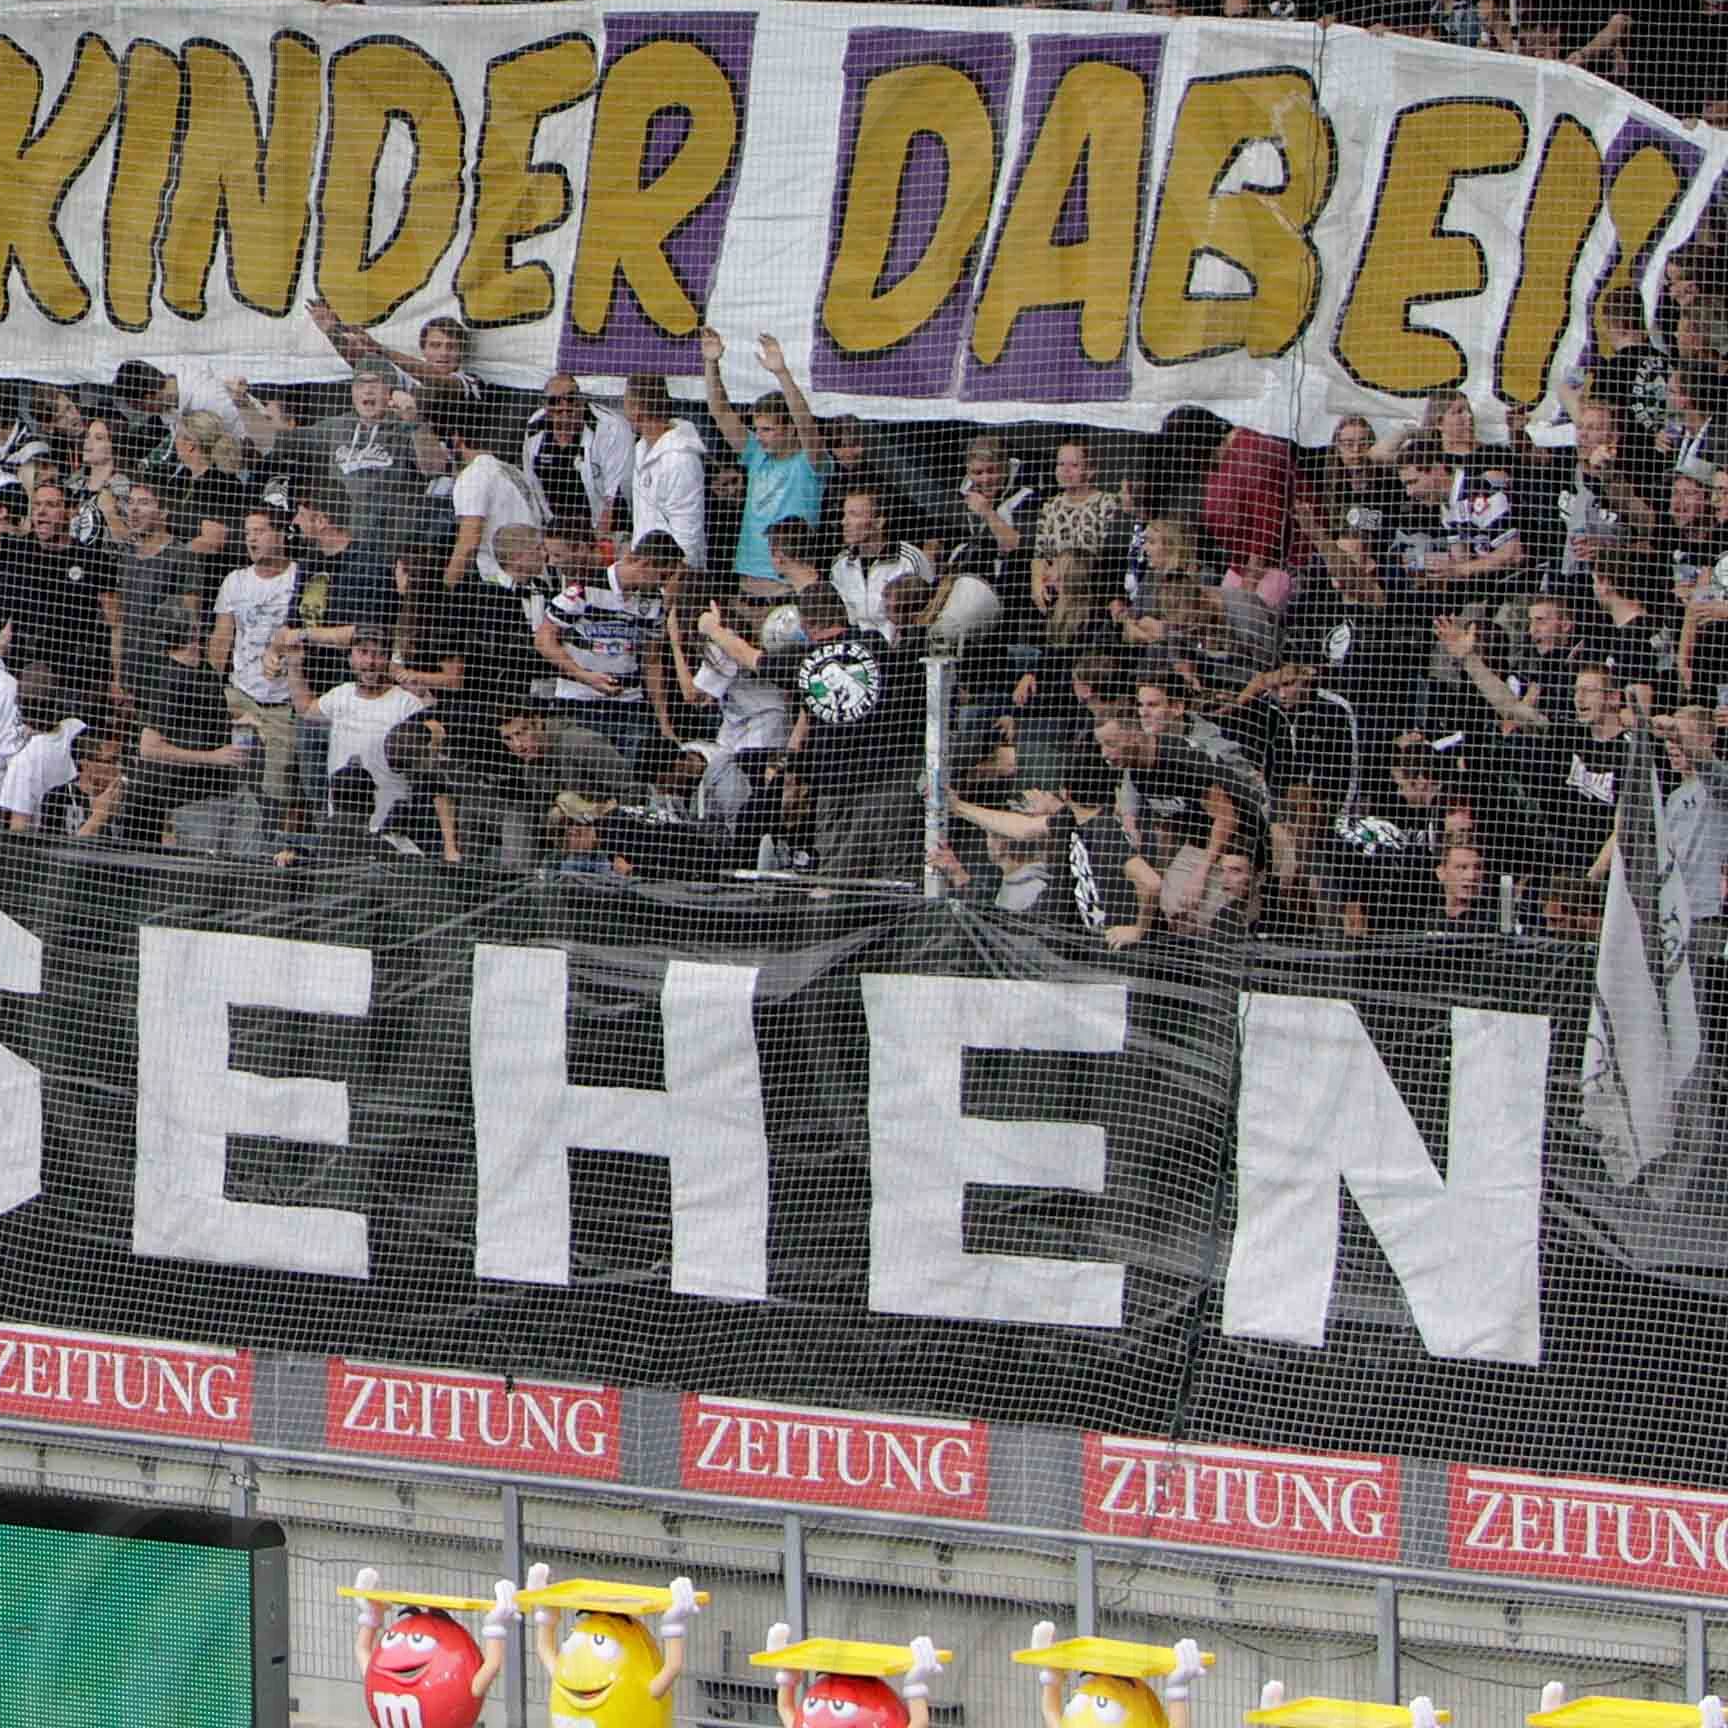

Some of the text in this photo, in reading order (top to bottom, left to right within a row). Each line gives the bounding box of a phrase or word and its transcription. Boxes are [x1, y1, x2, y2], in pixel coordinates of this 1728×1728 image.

[342, 1373, 609, 1459] ZEITUNG
[695, 1412, 974, 1497] ZEITUNG
[1098, 1453, 1385, 1539] ZEITUNG
